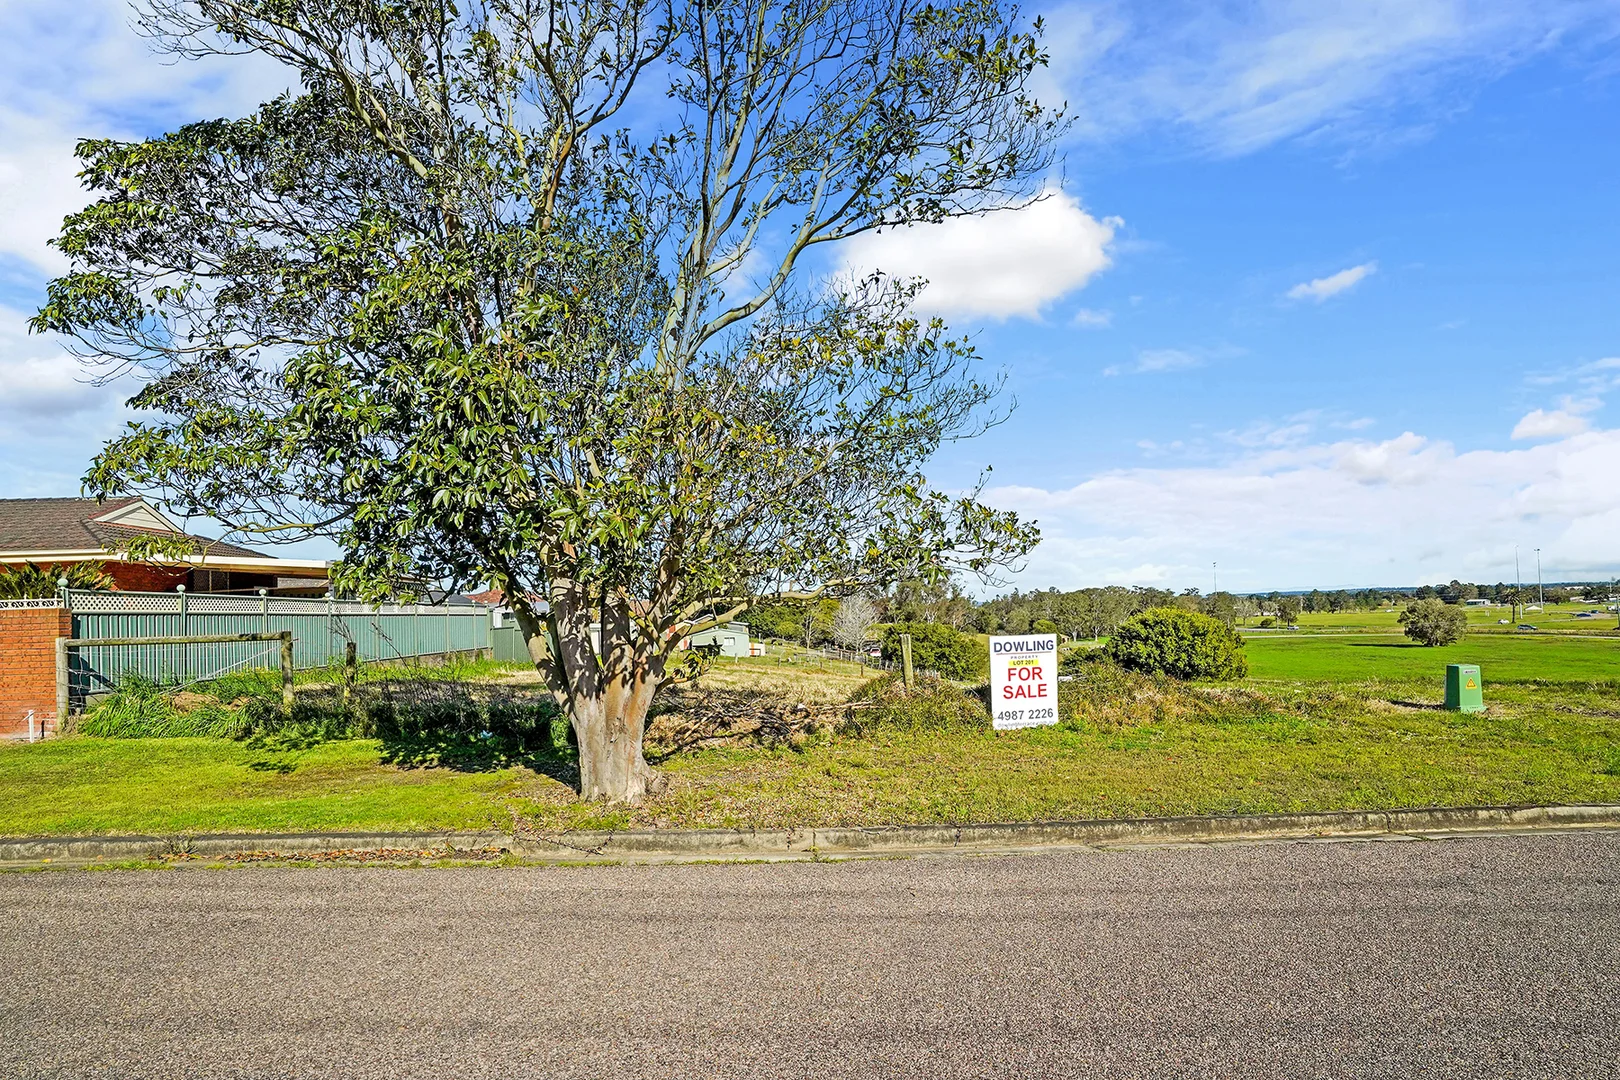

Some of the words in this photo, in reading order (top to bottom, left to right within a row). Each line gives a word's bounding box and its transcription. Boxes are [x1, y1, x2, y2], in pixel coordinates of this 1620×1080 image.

[993, 640, 1054, 653] DOWLING
[1008, 667, 1042, 681] FOR
[1003, 684, 1047, 699] SALE
[998, 710, 1024, 720] 4987
[1028, 708, 1053, 719] 2226
